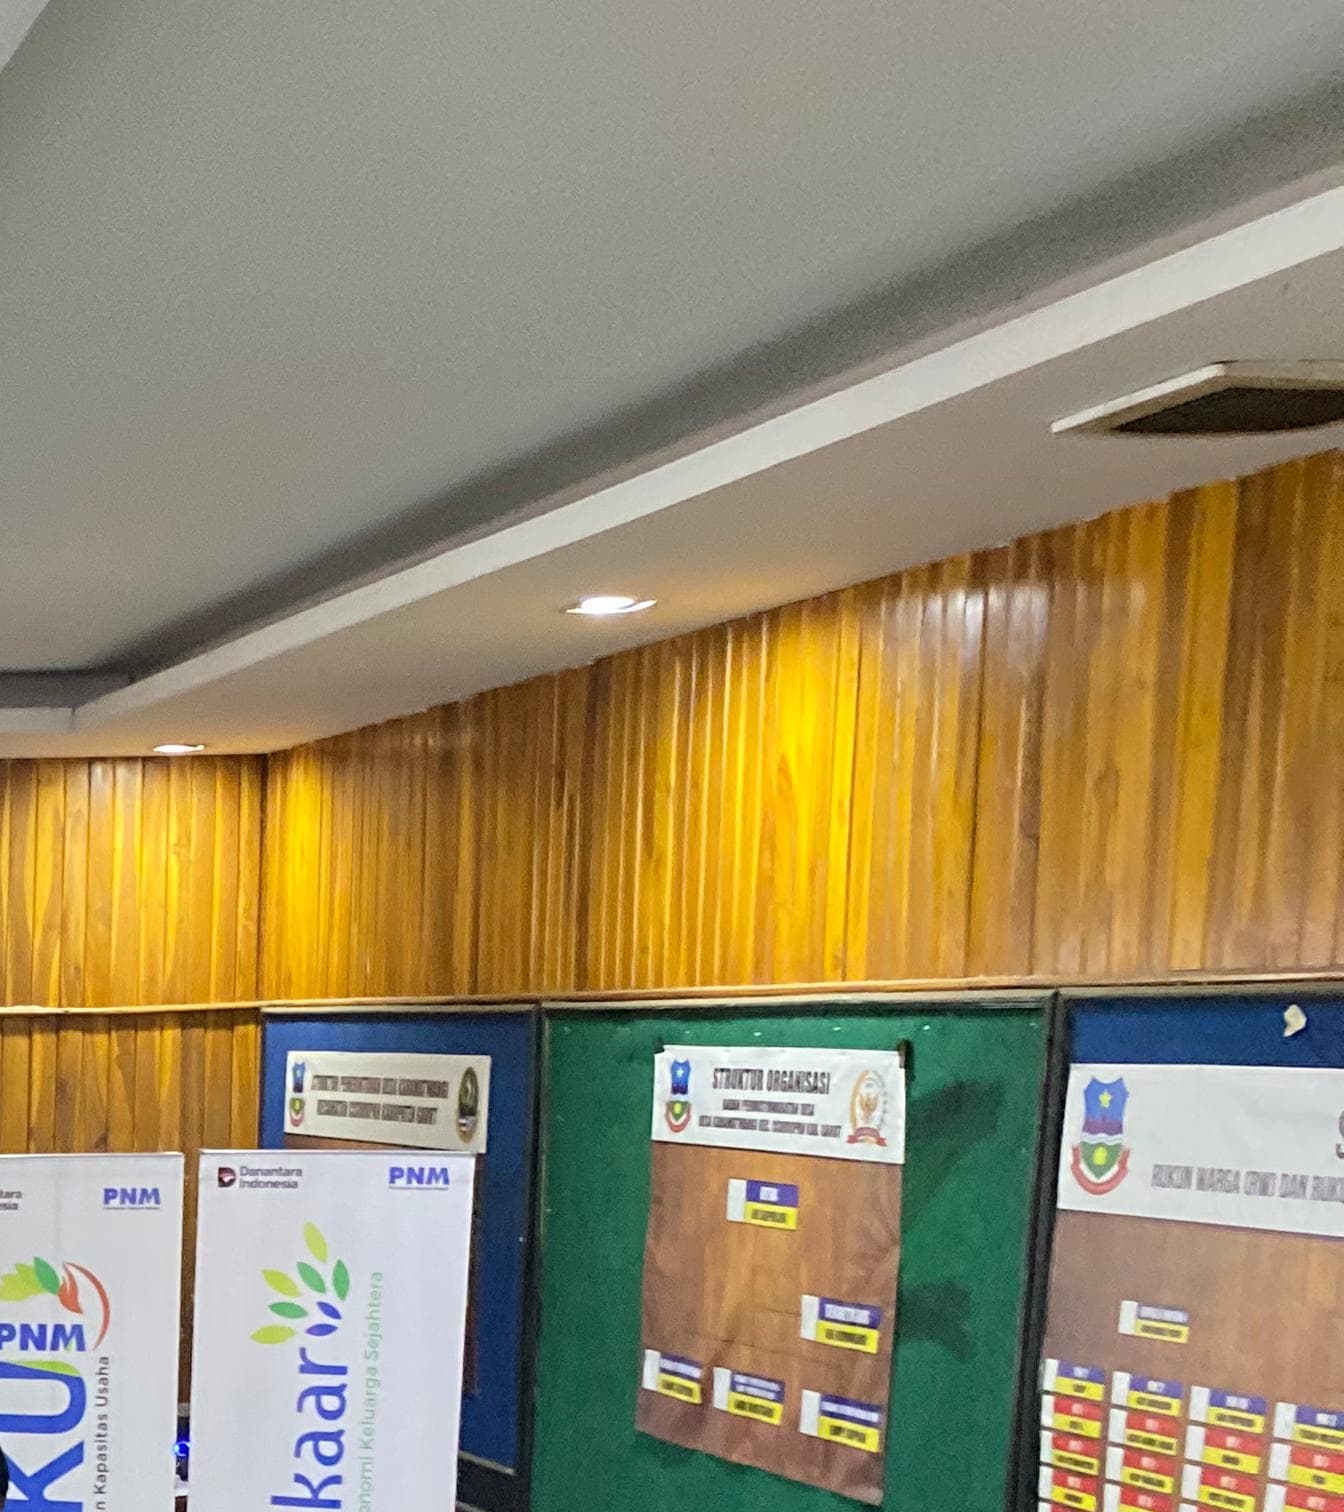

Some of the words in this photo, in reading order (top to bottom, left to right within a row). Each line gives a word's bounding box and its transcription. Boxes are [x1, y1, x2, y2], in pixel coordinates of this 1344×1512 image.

[712, 1068, 765, 1092] STRUKTUR
[766, 1069, 831, 1095] ORGANISASI
[240, 1166, 303, 1178] Danantara
[240, 1178, 299, 1190] Indonesia
[389, 1166, 450, 1185] PNM
[103, 1187, 161, 1206] PNM
[364, 1271, 384, 1362] Sejahtera
[95, 1356, 110, 1409] Usaha
[360, 1366, 381, 1450] Keluarga
[94, 1413, 110, 1495] Kapasitas
